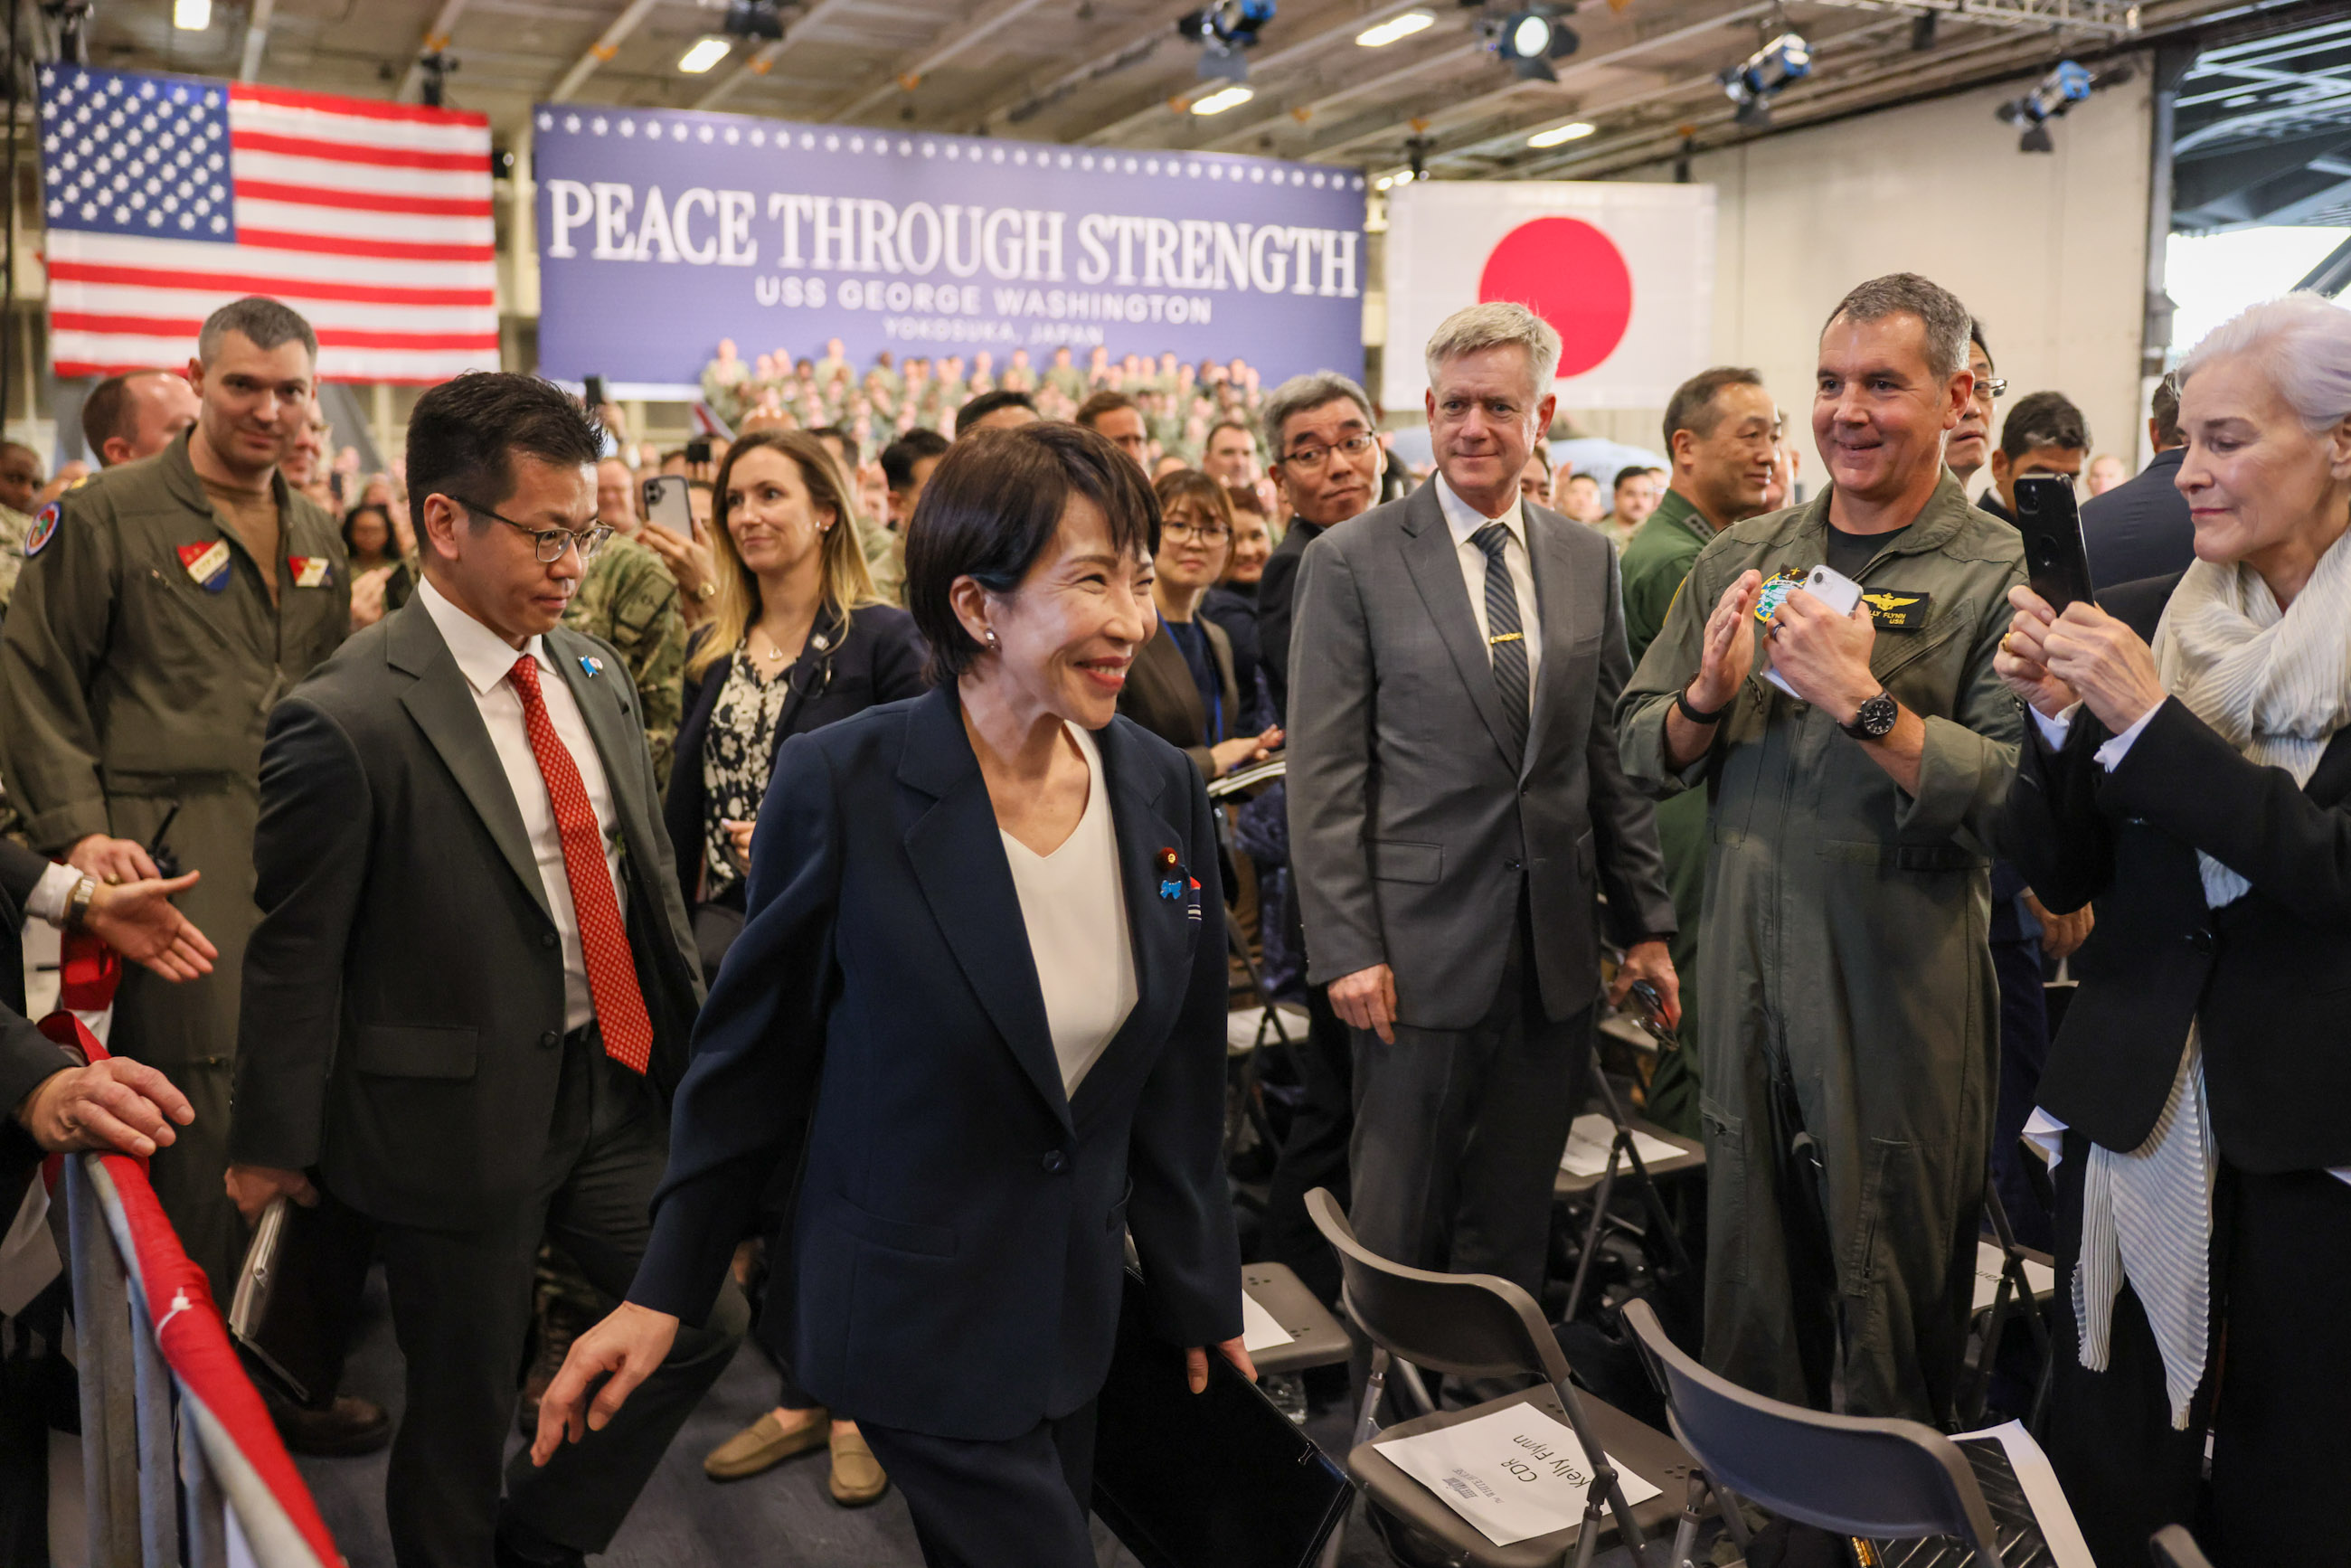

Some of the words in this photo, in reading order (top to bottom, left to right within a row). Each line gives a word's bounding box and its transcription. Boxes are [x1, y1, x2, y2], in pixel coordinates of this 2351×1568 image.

[546, 178, 759, 267] PEACE
[767, 192, 1067, 284] THROUGH
[1076, 212, 1360, 298] STRENGTH
[754, 275, 827, 308] USS
[836, 279, 982, 316] GEORGE
[993, 286, 1213, 325] WASHINGTON
[1028, 322, 1104, 346] JAPAN
[1883, 611, 1907, 619] FLYNN
[1513, 1434, 1555, 1460] Flynn
[1501, 1458, 1537, 1482] CDR
[1549, 1459, 1591, 1488] Kelly
